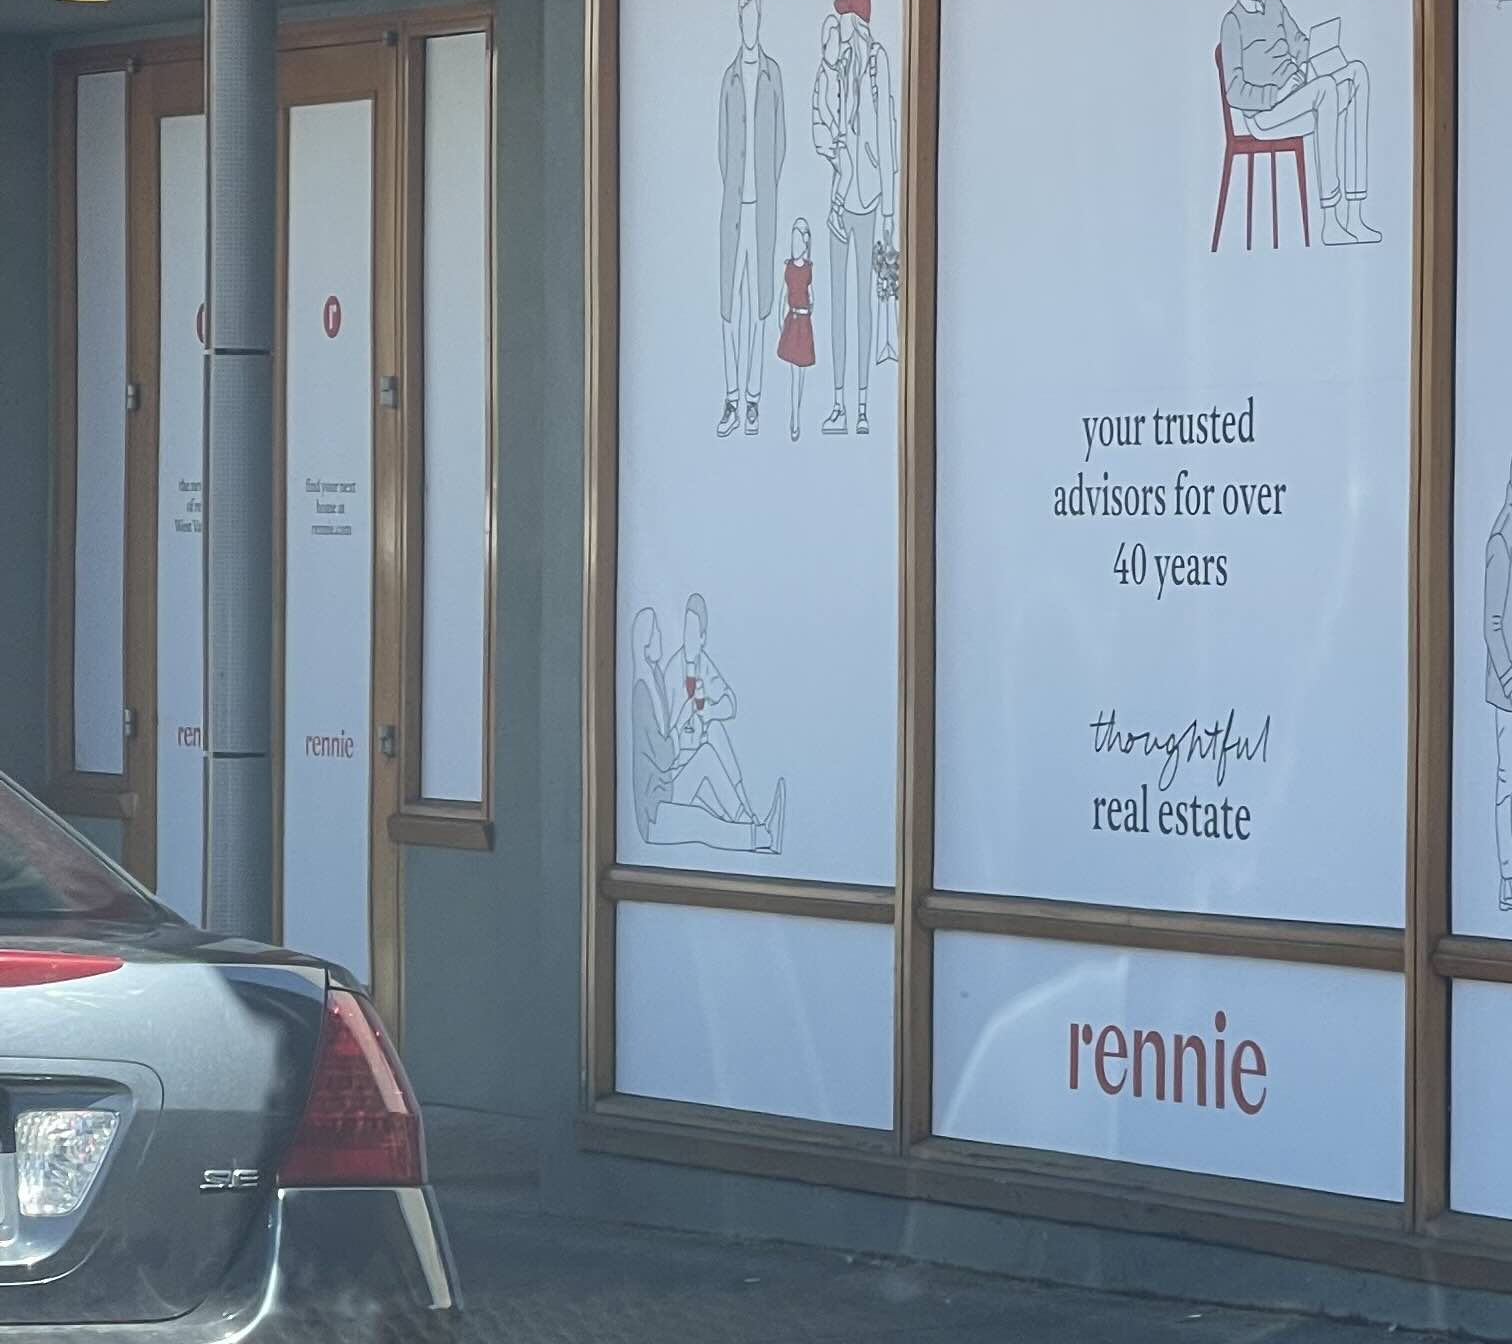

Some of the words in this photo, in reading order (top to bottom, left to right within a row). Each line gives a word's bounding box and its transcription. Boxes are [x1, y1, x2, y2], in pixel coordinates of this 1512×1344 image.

[1081, 414, 1146, 462] your
[1152, 395, 1255, 445] trusted
[1053, 471, 1167, 516] advisors
[1173, 469, 1216, 516] for
[1222, 482, 1287, 516] over
[1113, 542, 1147, 585] 40
[1153, 554, 1228, 601] years
[177, 725, 202, 748] ren
[305, 729, 354, 758] rennie
[1089, 707, 1271, 792] thoughtful
[1092, 783, 1150, 833] real
[1157, 795, 1252, 840] estate
[1068, 1010, 1268, 1116] rennie
